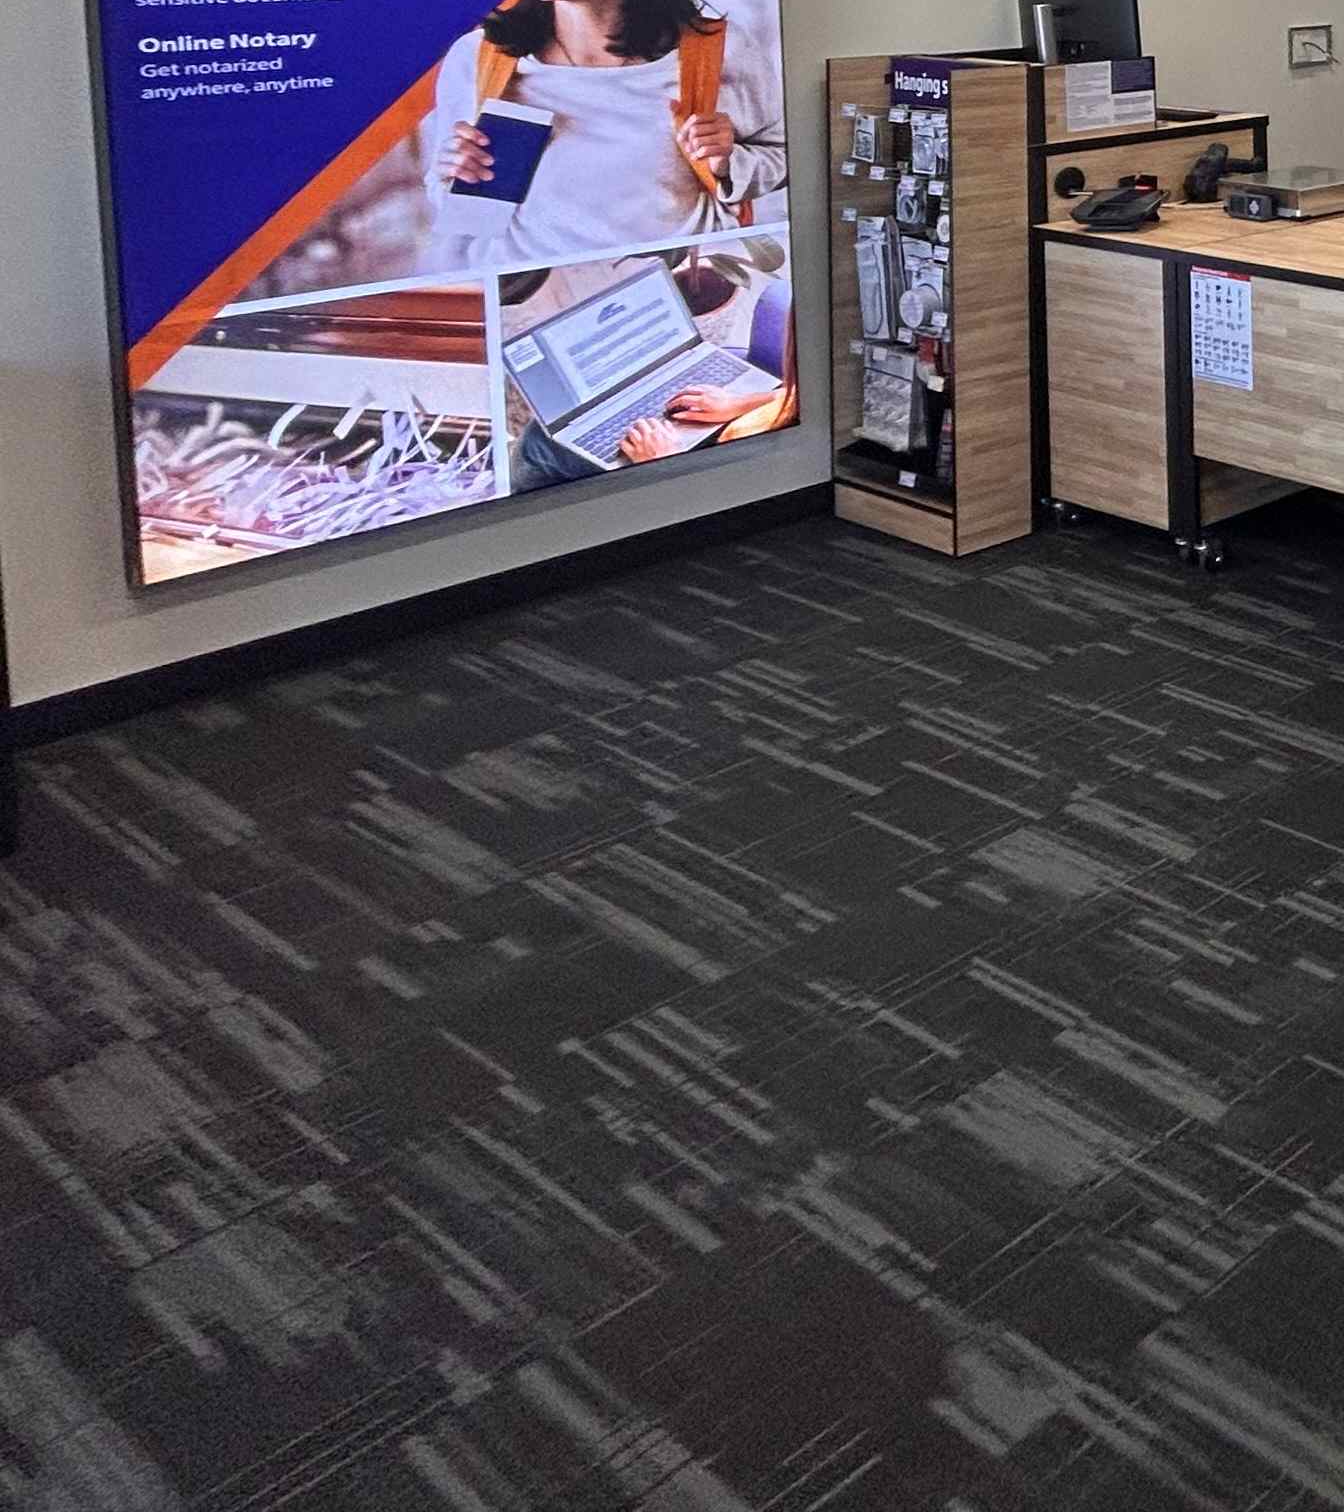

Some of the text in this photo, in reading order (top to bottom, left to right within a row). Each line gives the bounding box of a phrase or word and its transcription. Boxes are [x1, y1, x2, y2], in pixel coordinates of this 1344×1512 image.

[138, 32, 317, 53] Online Notary
[139, 57, 283, 78] Get notarized
[140, 76, 334, 101] anywhere, anytime
[894, 71, 940, 99] Hanging
